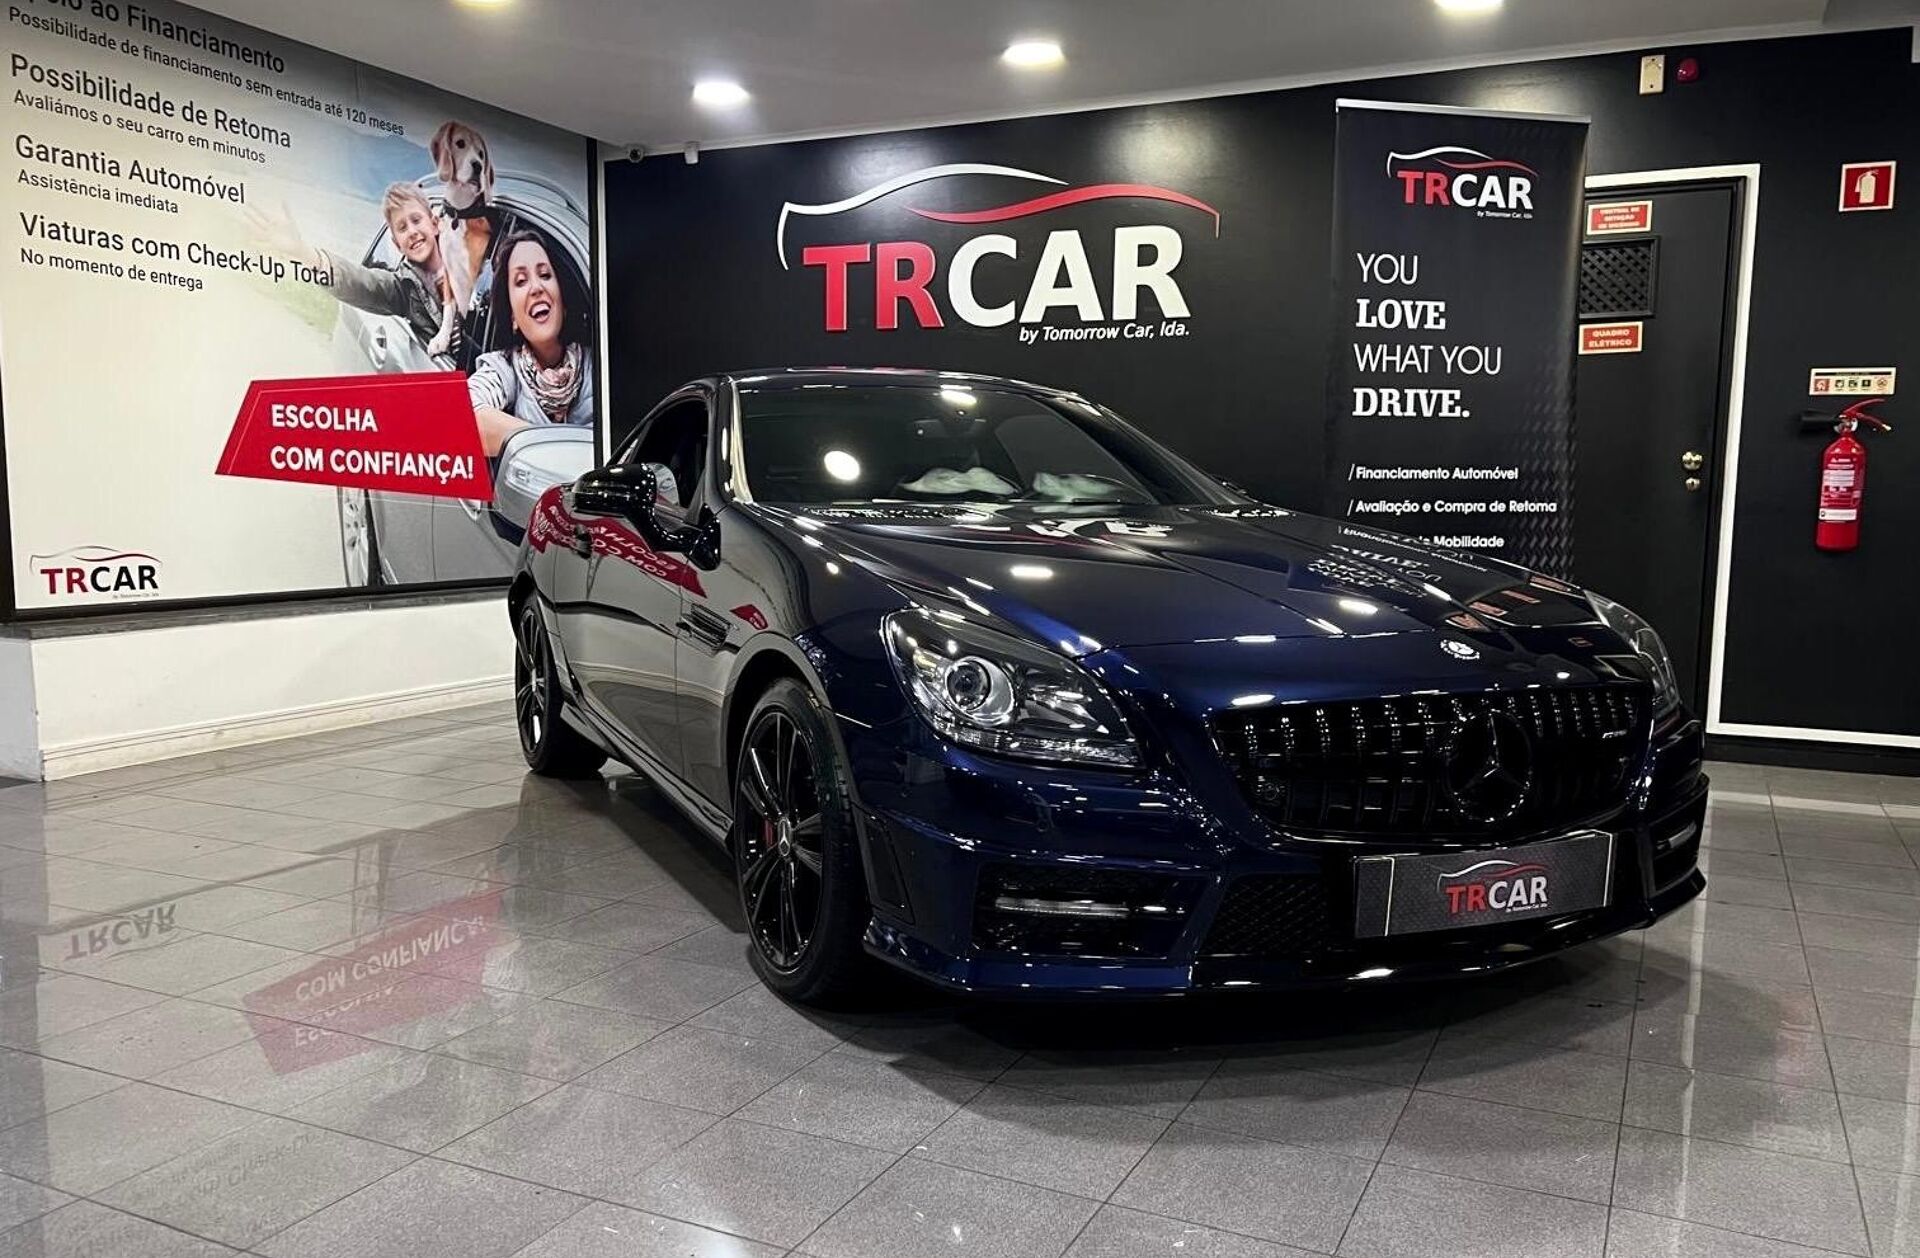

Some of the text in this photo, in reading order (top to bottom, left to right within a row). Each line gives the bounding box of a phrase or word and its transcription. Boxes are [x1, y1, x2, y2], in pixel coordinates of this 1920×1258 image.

[90, 0, 285, 74] ao Financiamento
[9, 6, 404, 136] Possibilidade de financiamento sem entrada até 120 meses
[11, 53, 291, 148] Possibilidade de Retoma
[14, 89, 265, 163] Avaliámos o seu carro em minutos
[15, 134, 244, 204] Garantia Automóvel
[18, 169, 178, 213] Assistência imediata
[1397, 170, 1533, 210] TRCAR
[20, 212, 334, 287] Viaturas com Check-Up Total
[21, 248, 203, 291] No momento de entrega
[803, 224, 1191, 332] TRCAR
[1357, 253, 1418, 285] YOU
[1355, 299, 1446, 329] LOVE
[1019, 327, 1038, 345] by
[1043, 325, 1119, 341] Tomorrow
[1123, 323, 1154, 339] Car,
[1592, 329, 1630, 338] QUADRO
[1353, 343, 1501, 375] WHAT YOU
[271, 404, 378, 432] ESCOLHA
[1352, 388, 1470, 418] DRIVE.
[270, 446, 474, 484] COM CONFIANÇA!
[1356, 466, 1450, 479] Financiamento
[1452, 466, 1518, 479] Automóvel
[1356, 500, 1419, 515] Avaliação
[1422, 503, 1431, 512] e
[1434, 501, 1486, 515] Compra
[1489, 500, 1506, 512] de
[1509, 501, 1557, 512] Retoma
[1434, 535, 1504, 547] Mobilidade
[40, 565, 158, 594] TRCAR
[1446, 876, 1548, 913] TRCAR
